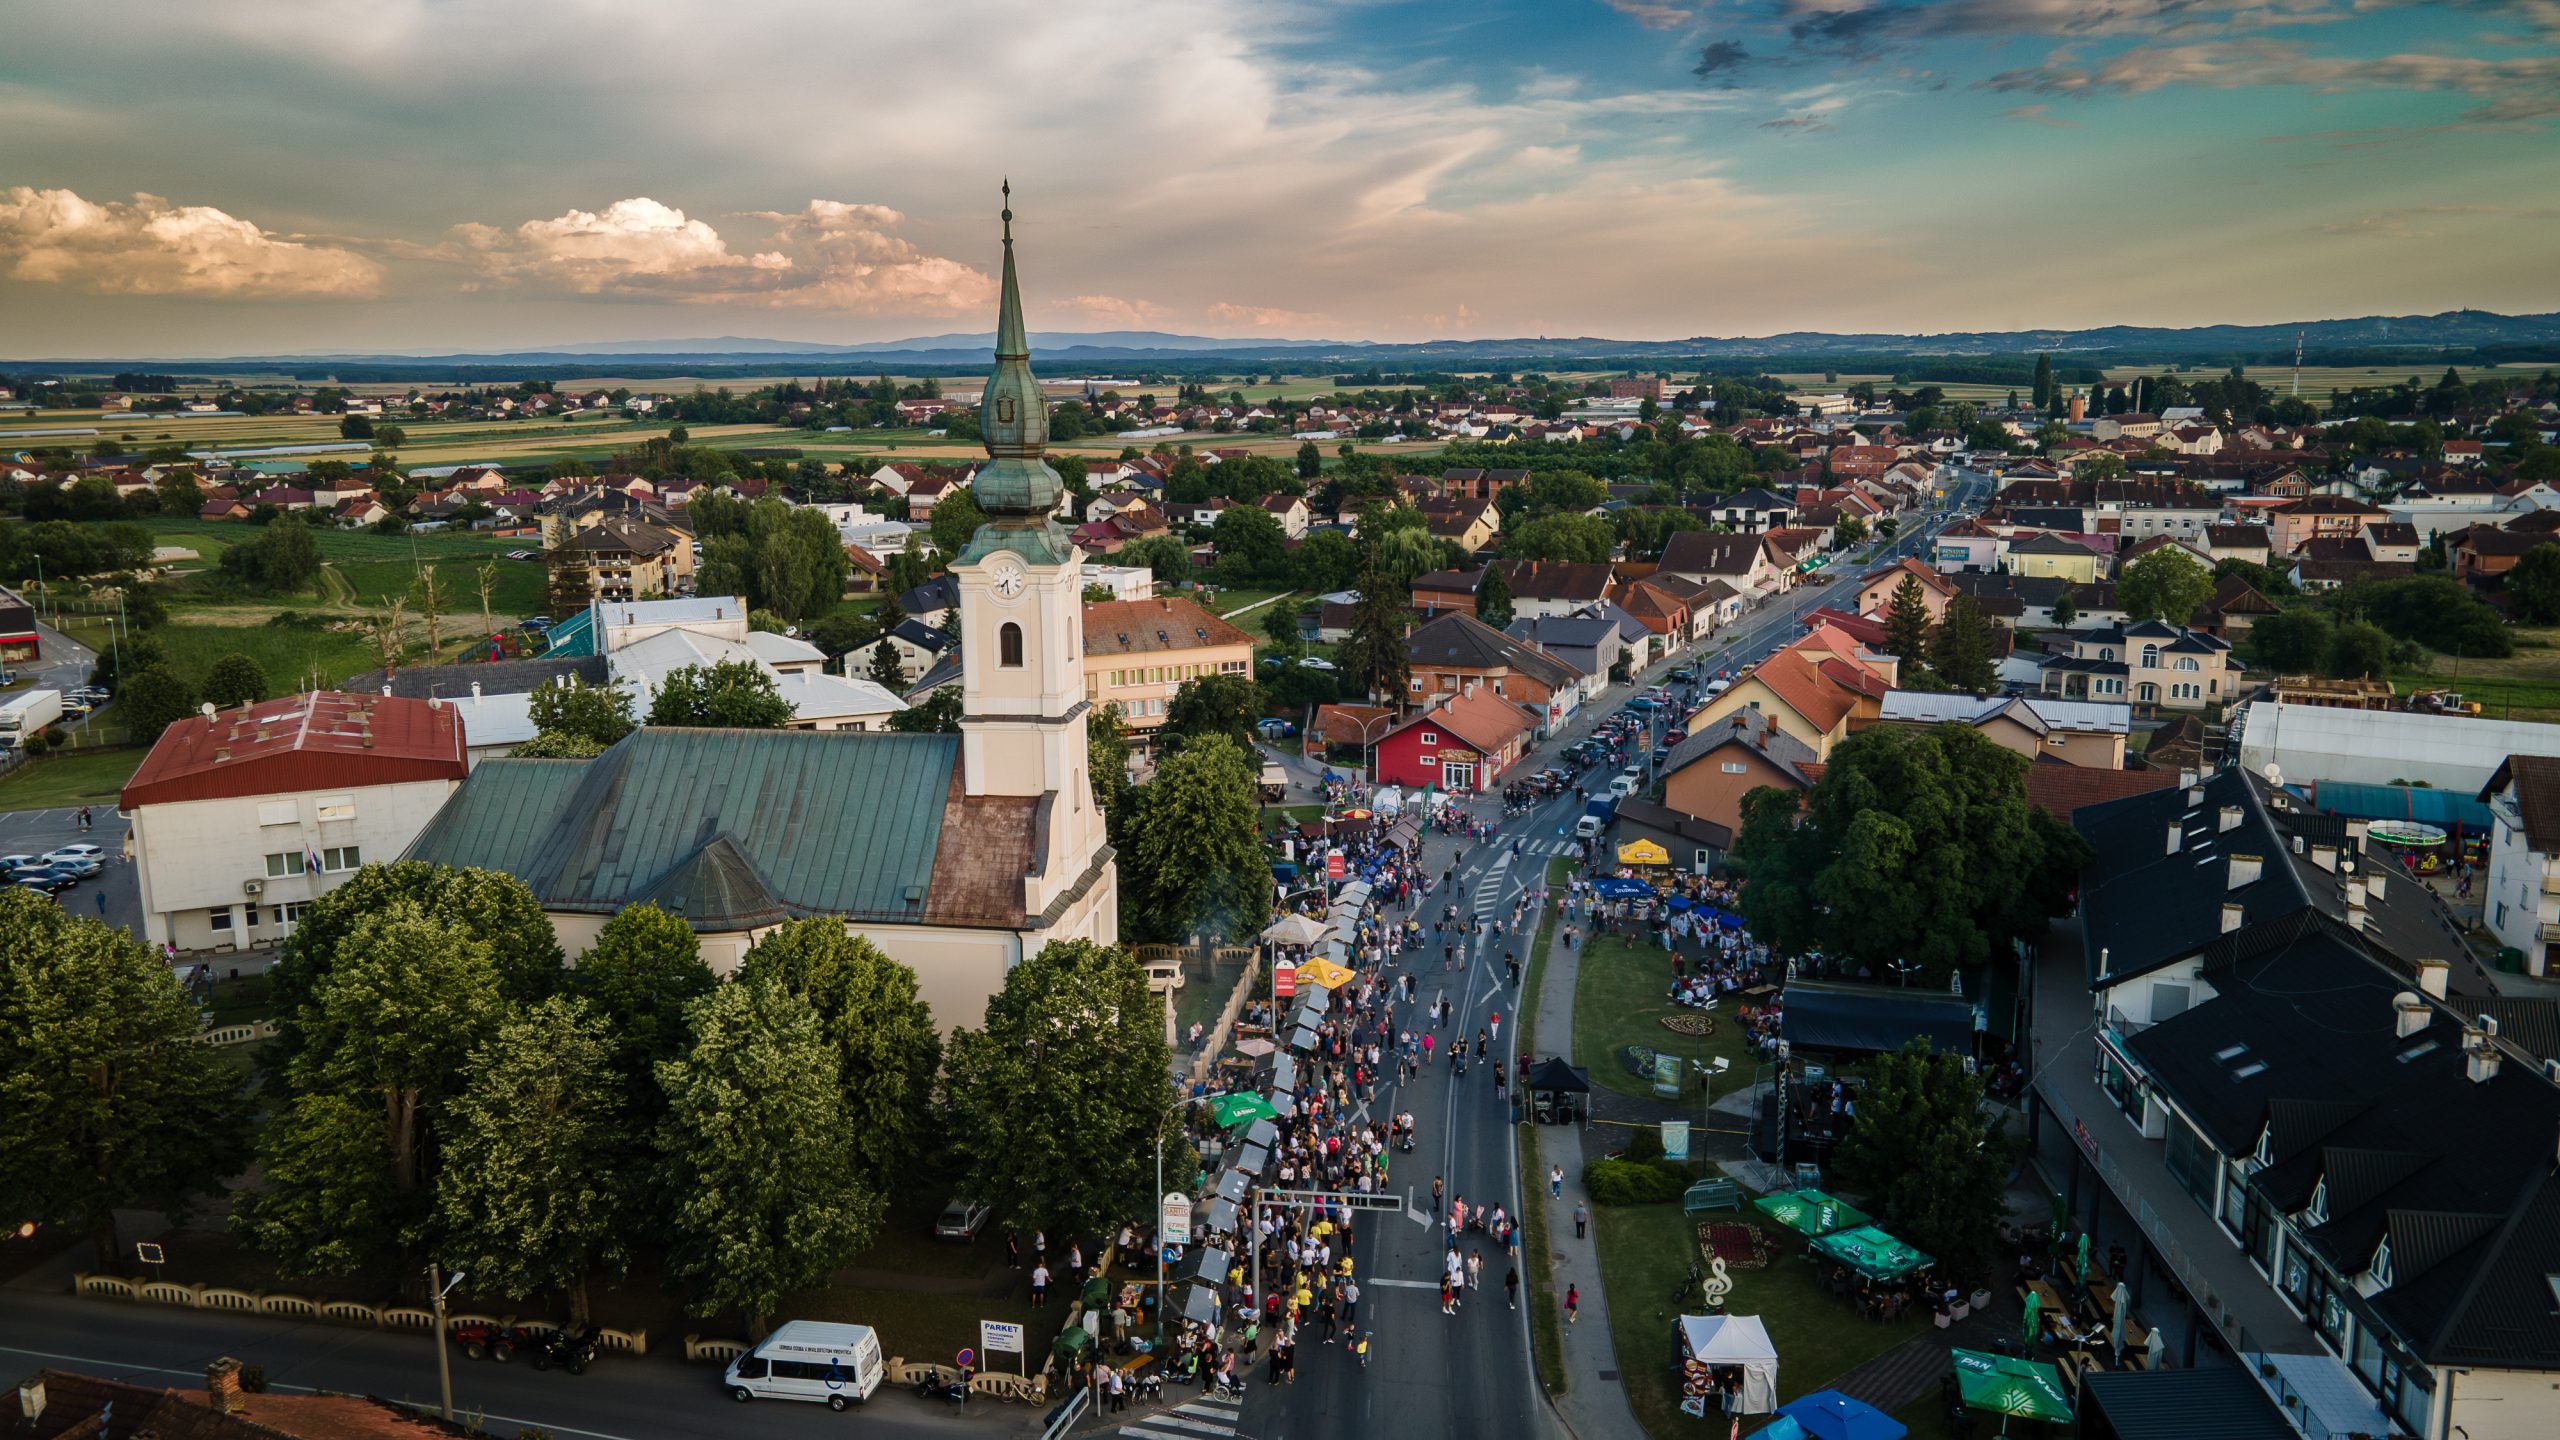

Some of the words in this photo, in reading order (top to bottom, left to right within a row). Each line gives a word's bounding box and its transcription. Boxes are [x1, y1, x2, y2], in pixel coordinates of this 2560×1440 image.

[1821, 1206, 1832, 1226] PAN
[985, 1323, 1019, 1333] PARKET
[1961, 1358, 1992, 1371] PAN
